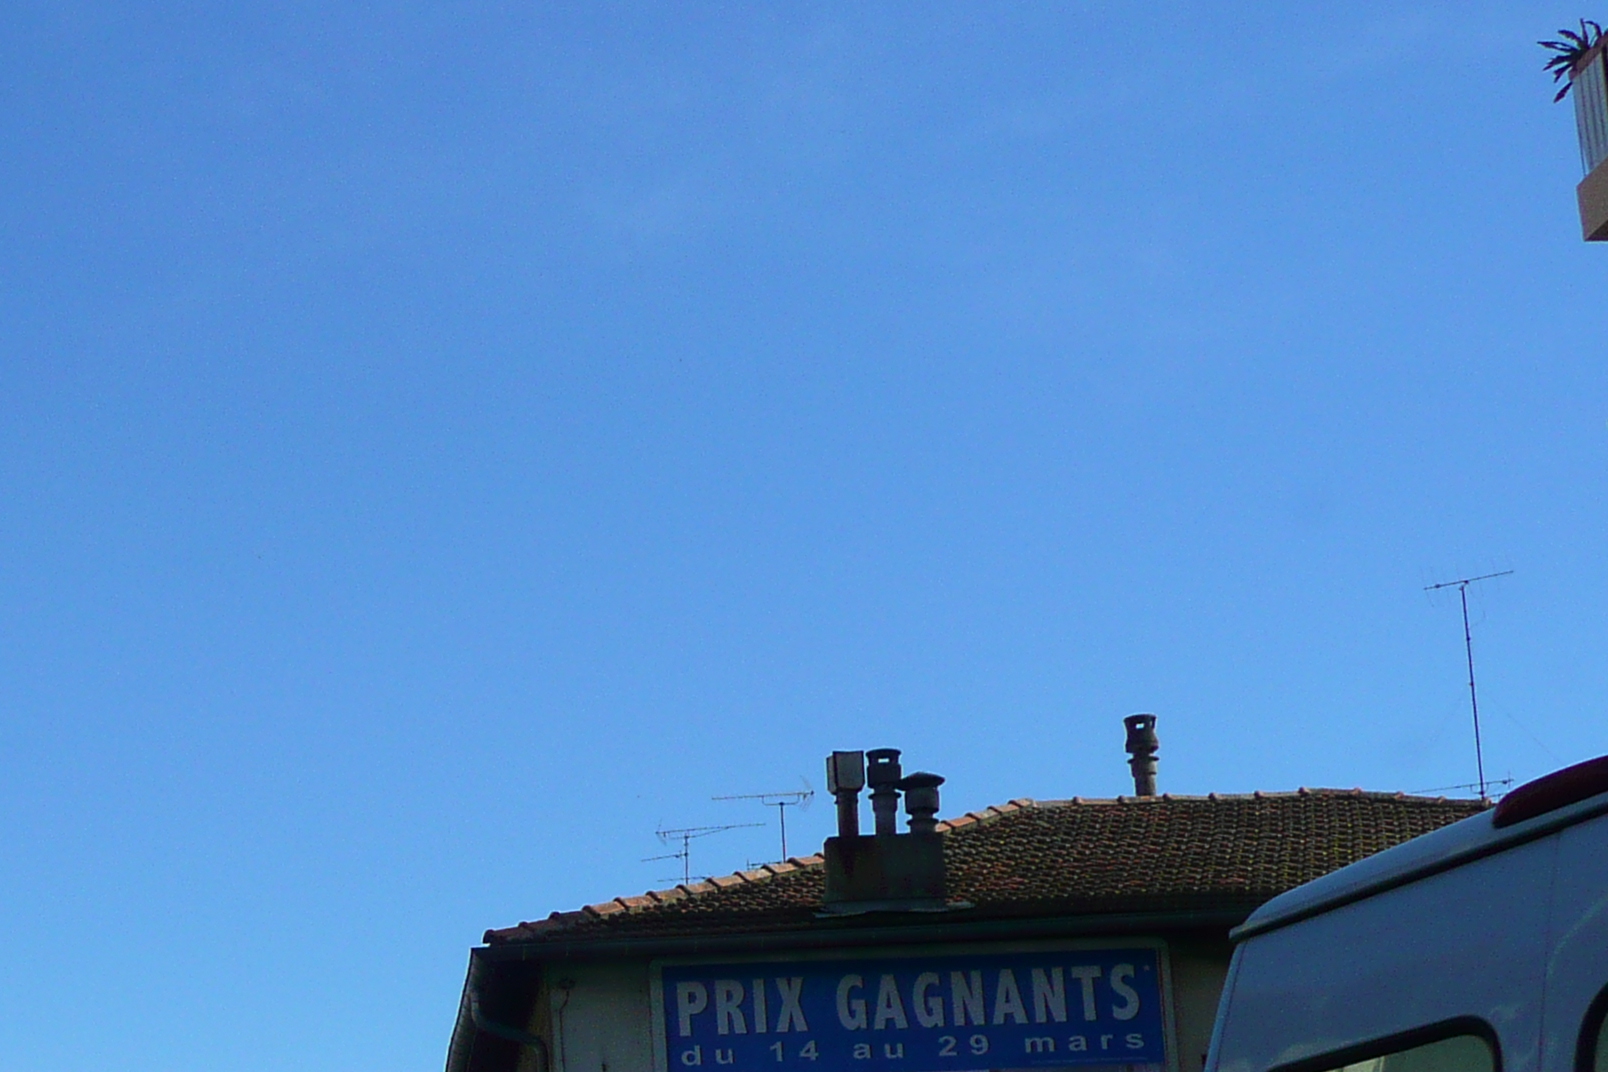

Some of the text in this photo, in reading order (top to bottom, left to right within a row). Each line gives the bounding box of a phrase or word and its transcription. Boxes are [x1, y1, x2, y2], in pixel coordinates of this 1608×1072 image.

[676, 977, 809, 1036] PRIX
[681, 1033, 1145, 1066] du 14 au 29 mars
